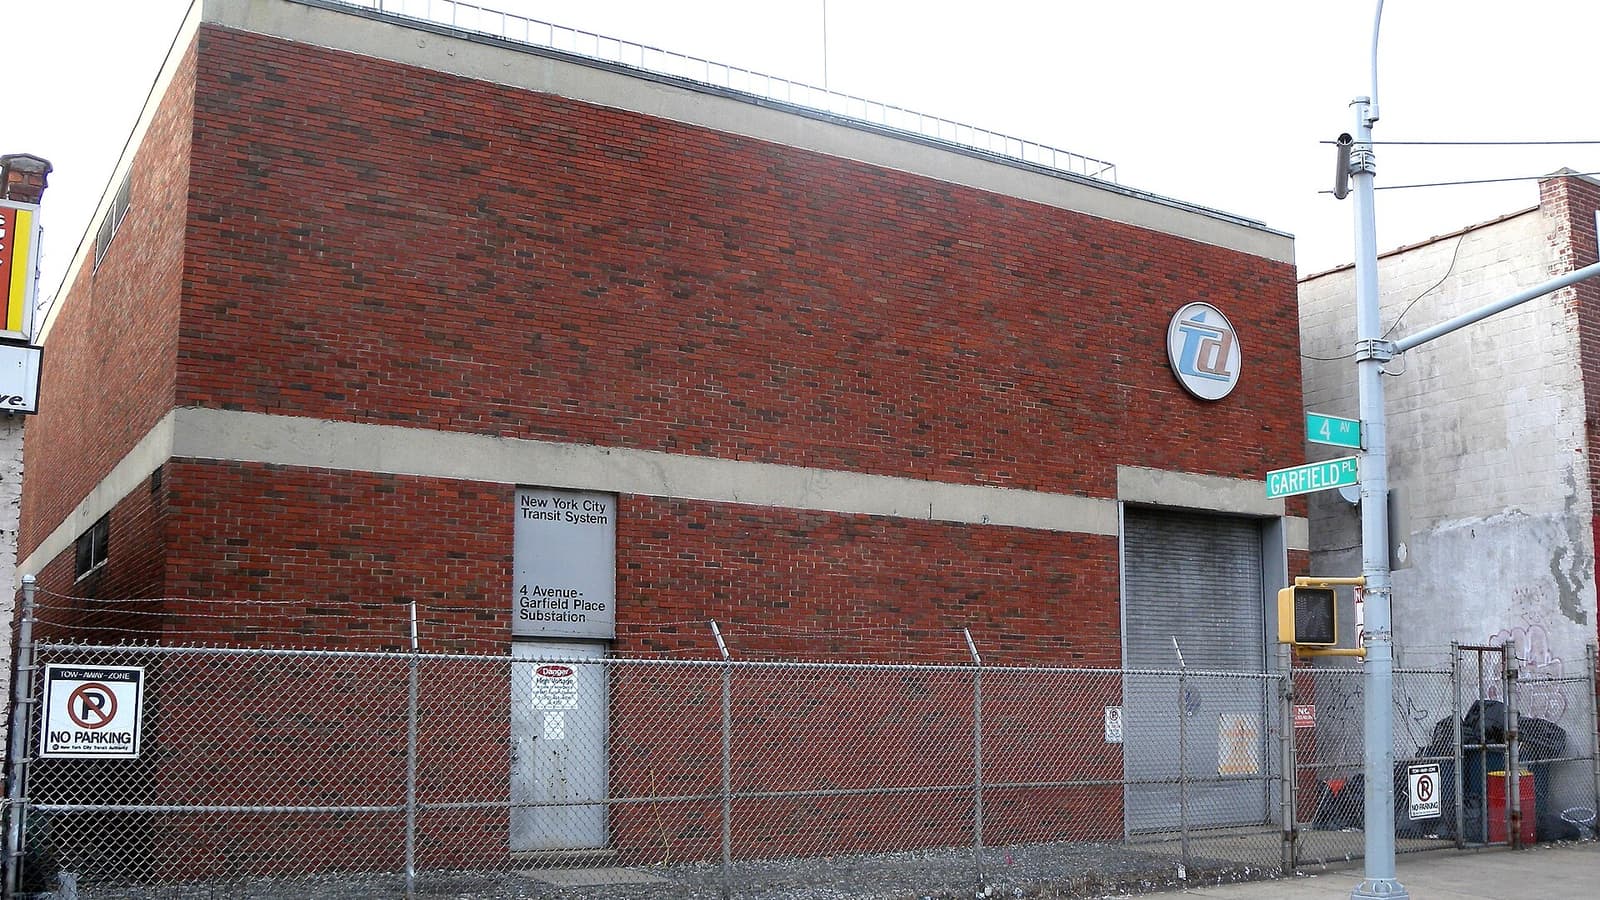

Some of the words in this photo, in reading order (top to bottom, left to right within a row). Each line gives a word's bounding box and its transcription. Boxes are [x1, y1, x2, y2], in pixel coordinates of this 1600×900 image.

[1319, 419, 1331, 440] 4
[1340, 421, 1351, 433] AV
[1270, 463, 1340, 495] GARFIELD
[1342, 461, 1354, 472] PL
[521, 495, 548, 508] New
[552, 497, 578, 511] York
[583, 500, 607, 514] City
[521, 507, 561, 521] Transit
[565, 510, 608, 524] System
[519, 585, 528, 596] 4
[519, 597, 569, 610] Garfield
[573, 600, 606, 611] Place
[519, 609, 586, 622] Substation
[50, 731, 71, 743] NO
[75, 732, 132, 744] PARKING
